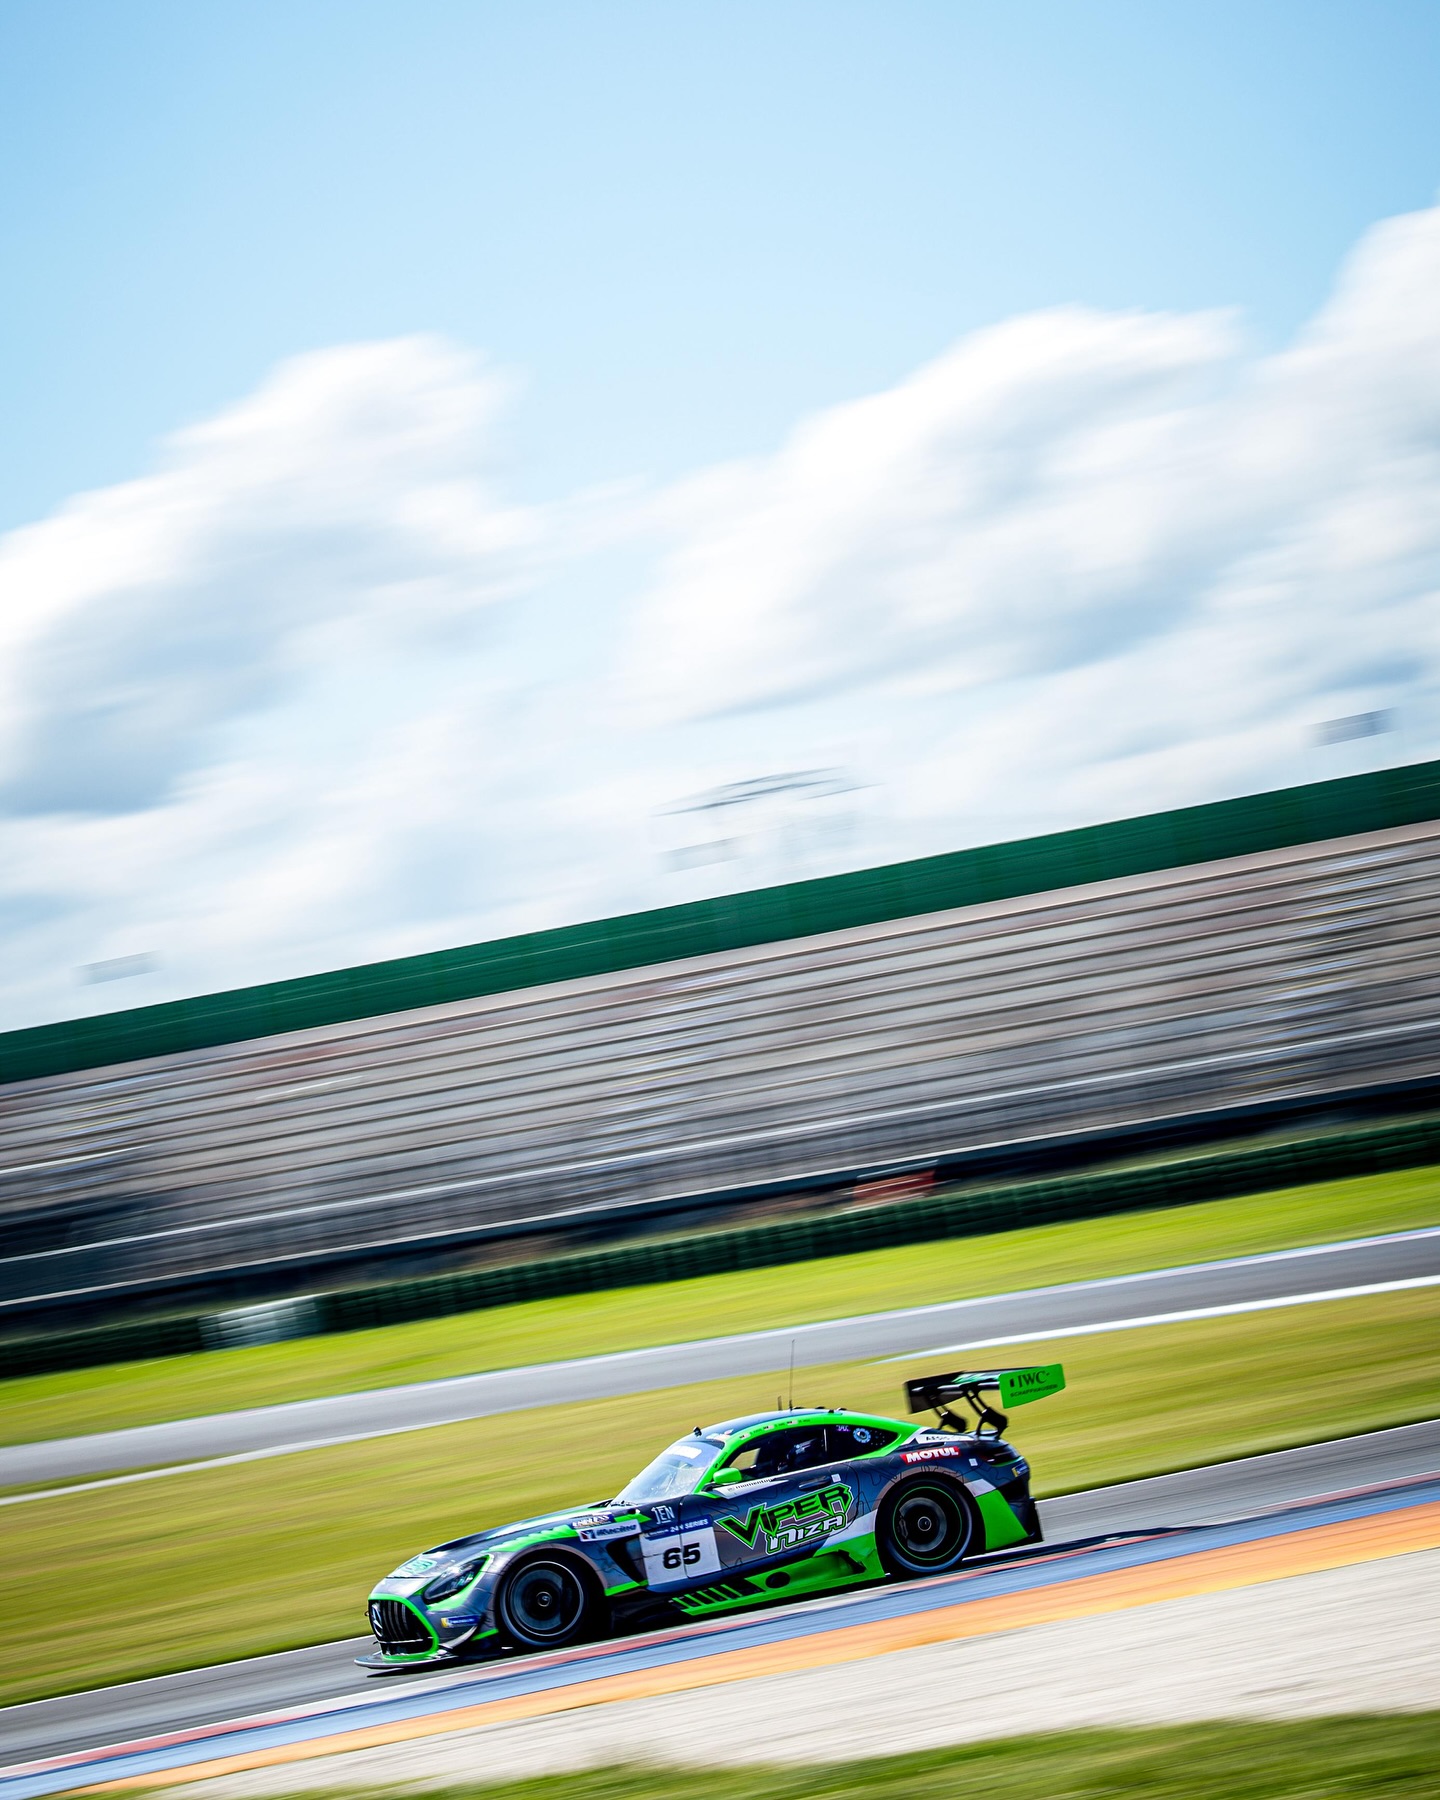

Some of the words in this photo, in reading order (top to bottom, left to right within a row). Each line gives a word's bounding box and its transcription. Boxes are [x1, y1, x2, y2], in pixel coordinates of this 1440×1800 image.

[1017, 1370, 1046, 1388] IWC
[907, 1447, 959, 1463] MOTUL
[684, 1519, 709, 1530] SERIES
[716, 1484, 854, 1549] VIPER
[663, 1542, 701, 1569] 65
